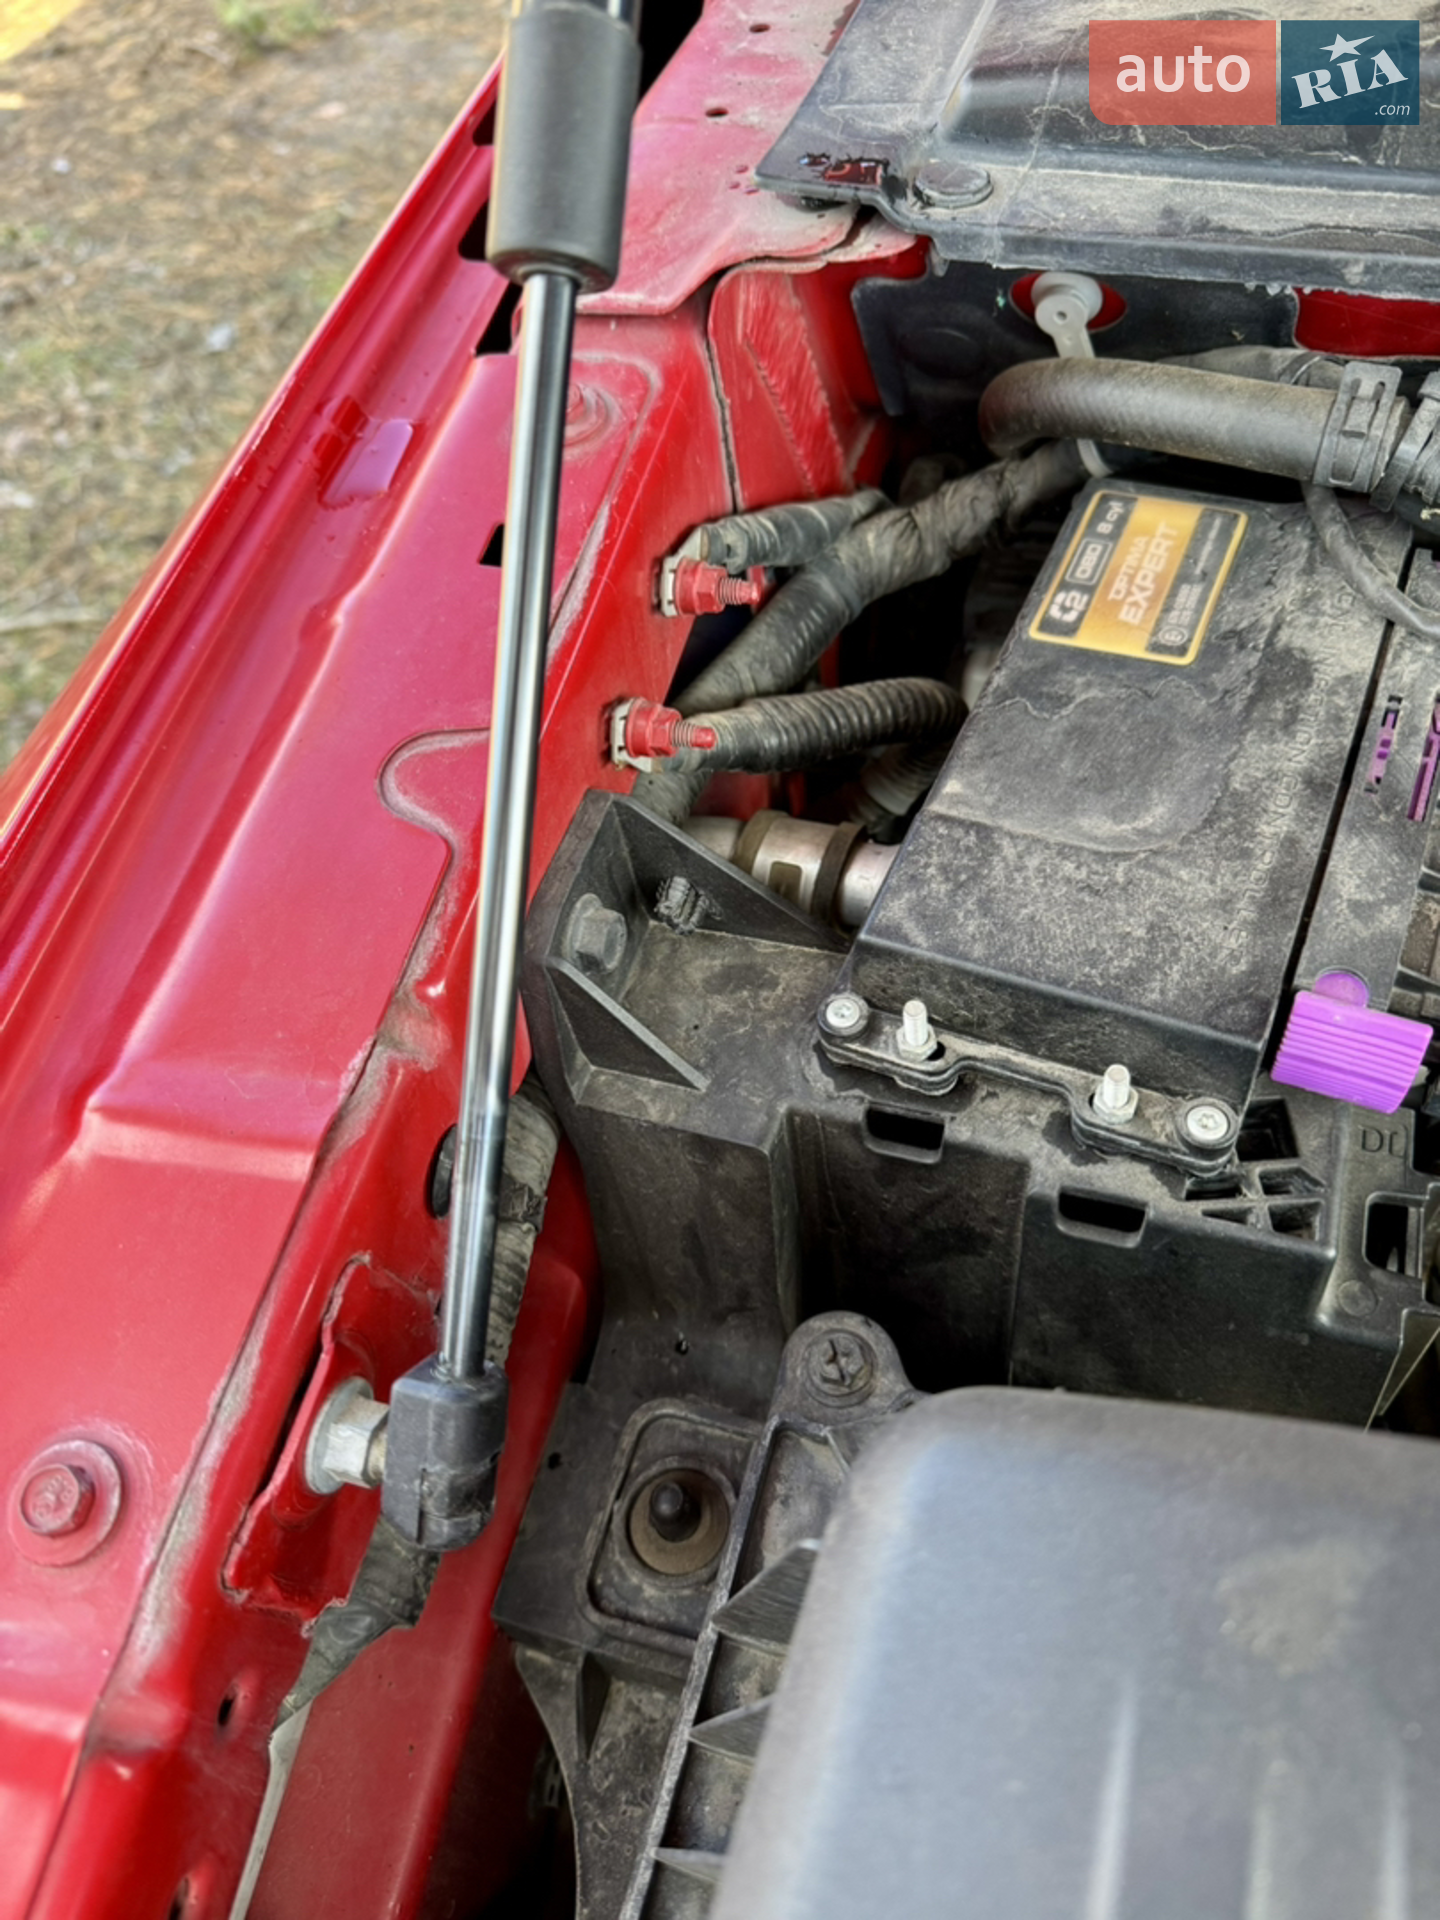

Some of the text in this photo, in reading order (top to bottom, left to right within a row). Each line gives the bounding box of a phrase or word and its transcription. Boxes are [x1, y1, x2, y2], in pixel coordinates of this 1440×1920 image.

[1075, 542, 1103, 579] OBD
[1106, 500, 1124, 522] cyl
[1108, 535, 1149, 602] OPTIMA
[1118, 520, 1178, 626] EXPERT
[1222, 774, 1298, 973] CONTROLLER
